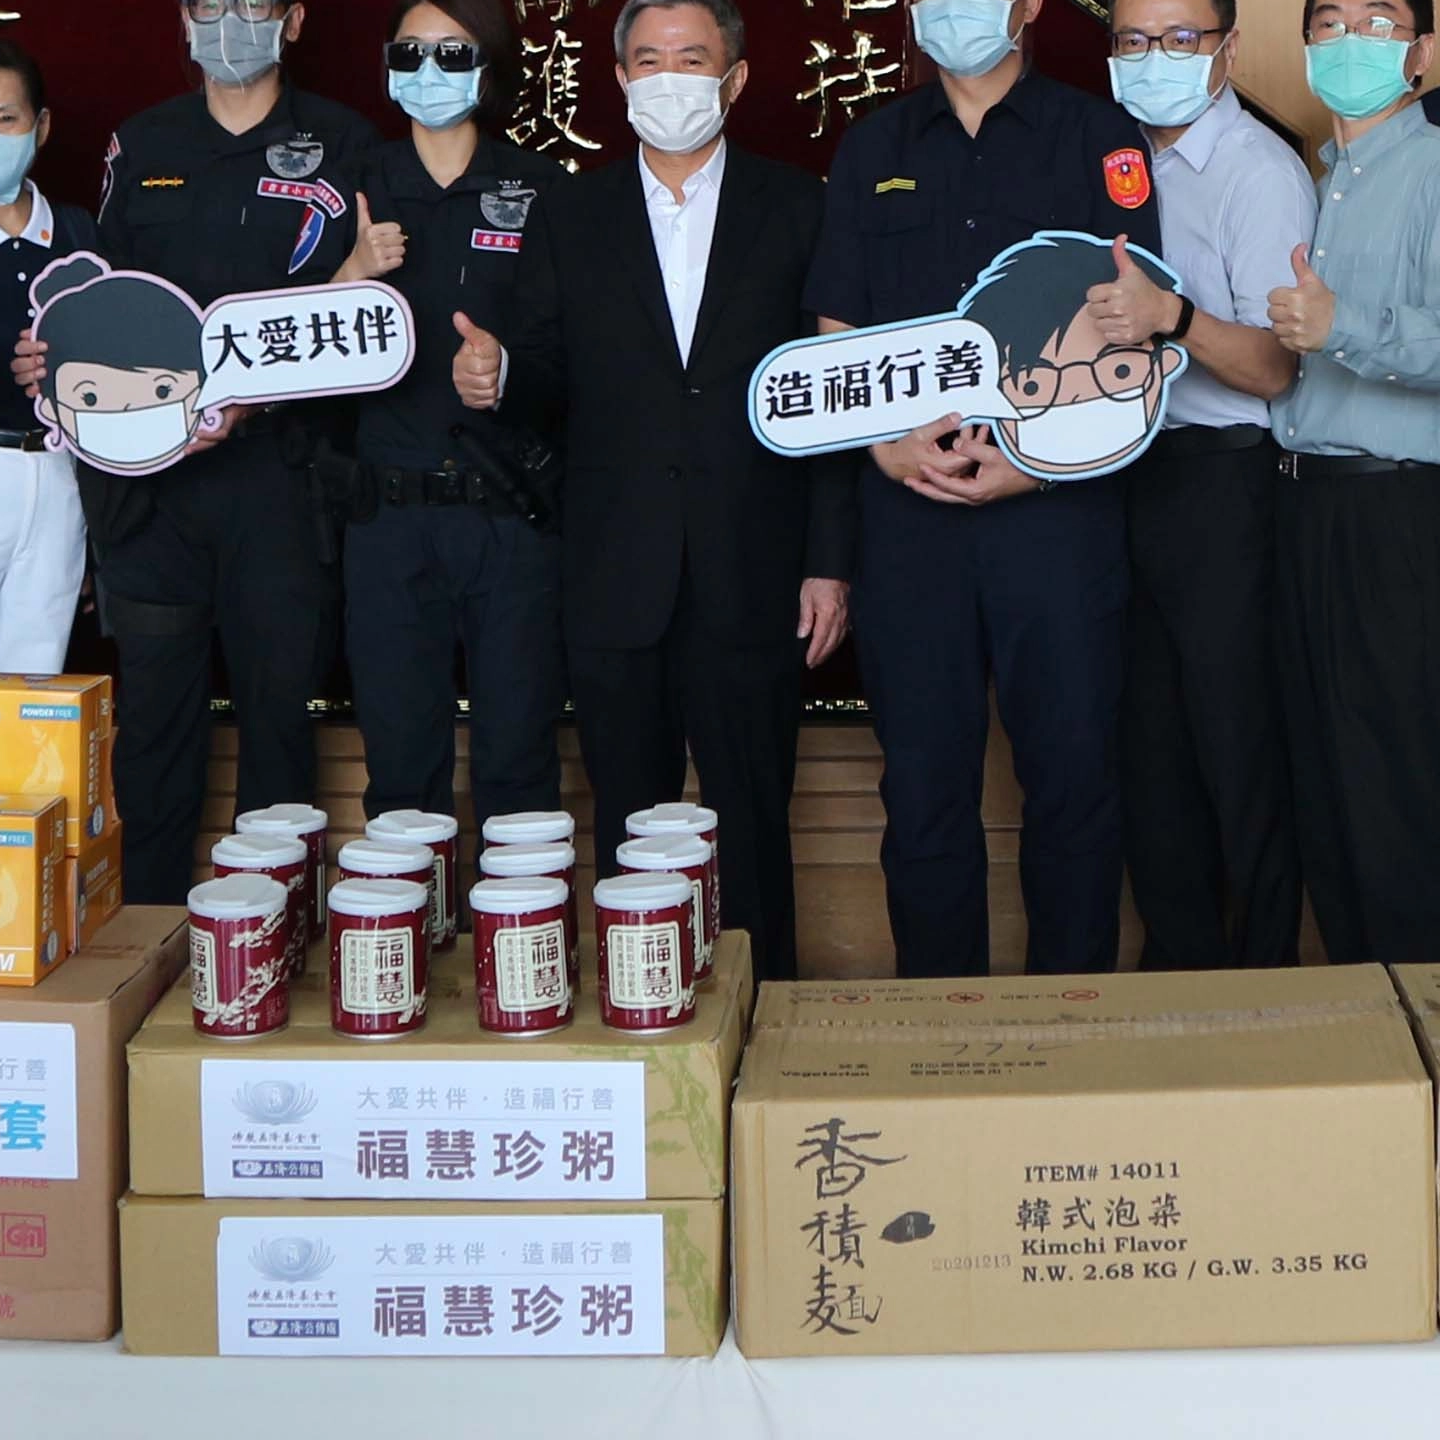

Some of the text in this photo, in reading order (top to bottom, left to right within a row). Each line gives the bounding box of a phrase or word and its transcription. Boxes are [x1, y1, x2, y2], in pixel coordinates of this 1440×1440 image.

[206, 306, 399, 373] 大愛共伴
[765, 340, 984, 422] 造福行善
[22, 708, 53, 717] POWDER
[8, 835, 27, 844] FREE
[373, 937, 404, 1003] 福慧
[532, 930, 560, 998] 福慧
[641, 931, 672, 998] 福慧
[356, 1129, 614, 1182] 福慧珍粥
[1026, 1163, 1177, 1182] ITEM# 14011
[795, 1118, 908, 1337] 香積麵
[1016, 1193, 1180, 1232] 韓式泡菜
[1023, 1231, 1187, 1255] Kimchi Flavor
[1023, 1254, 1366, 1281] N.W. 2.68 KG / G.W. 3.35 KG
[374, 1284, 633, 1338] 福慧珍粥
